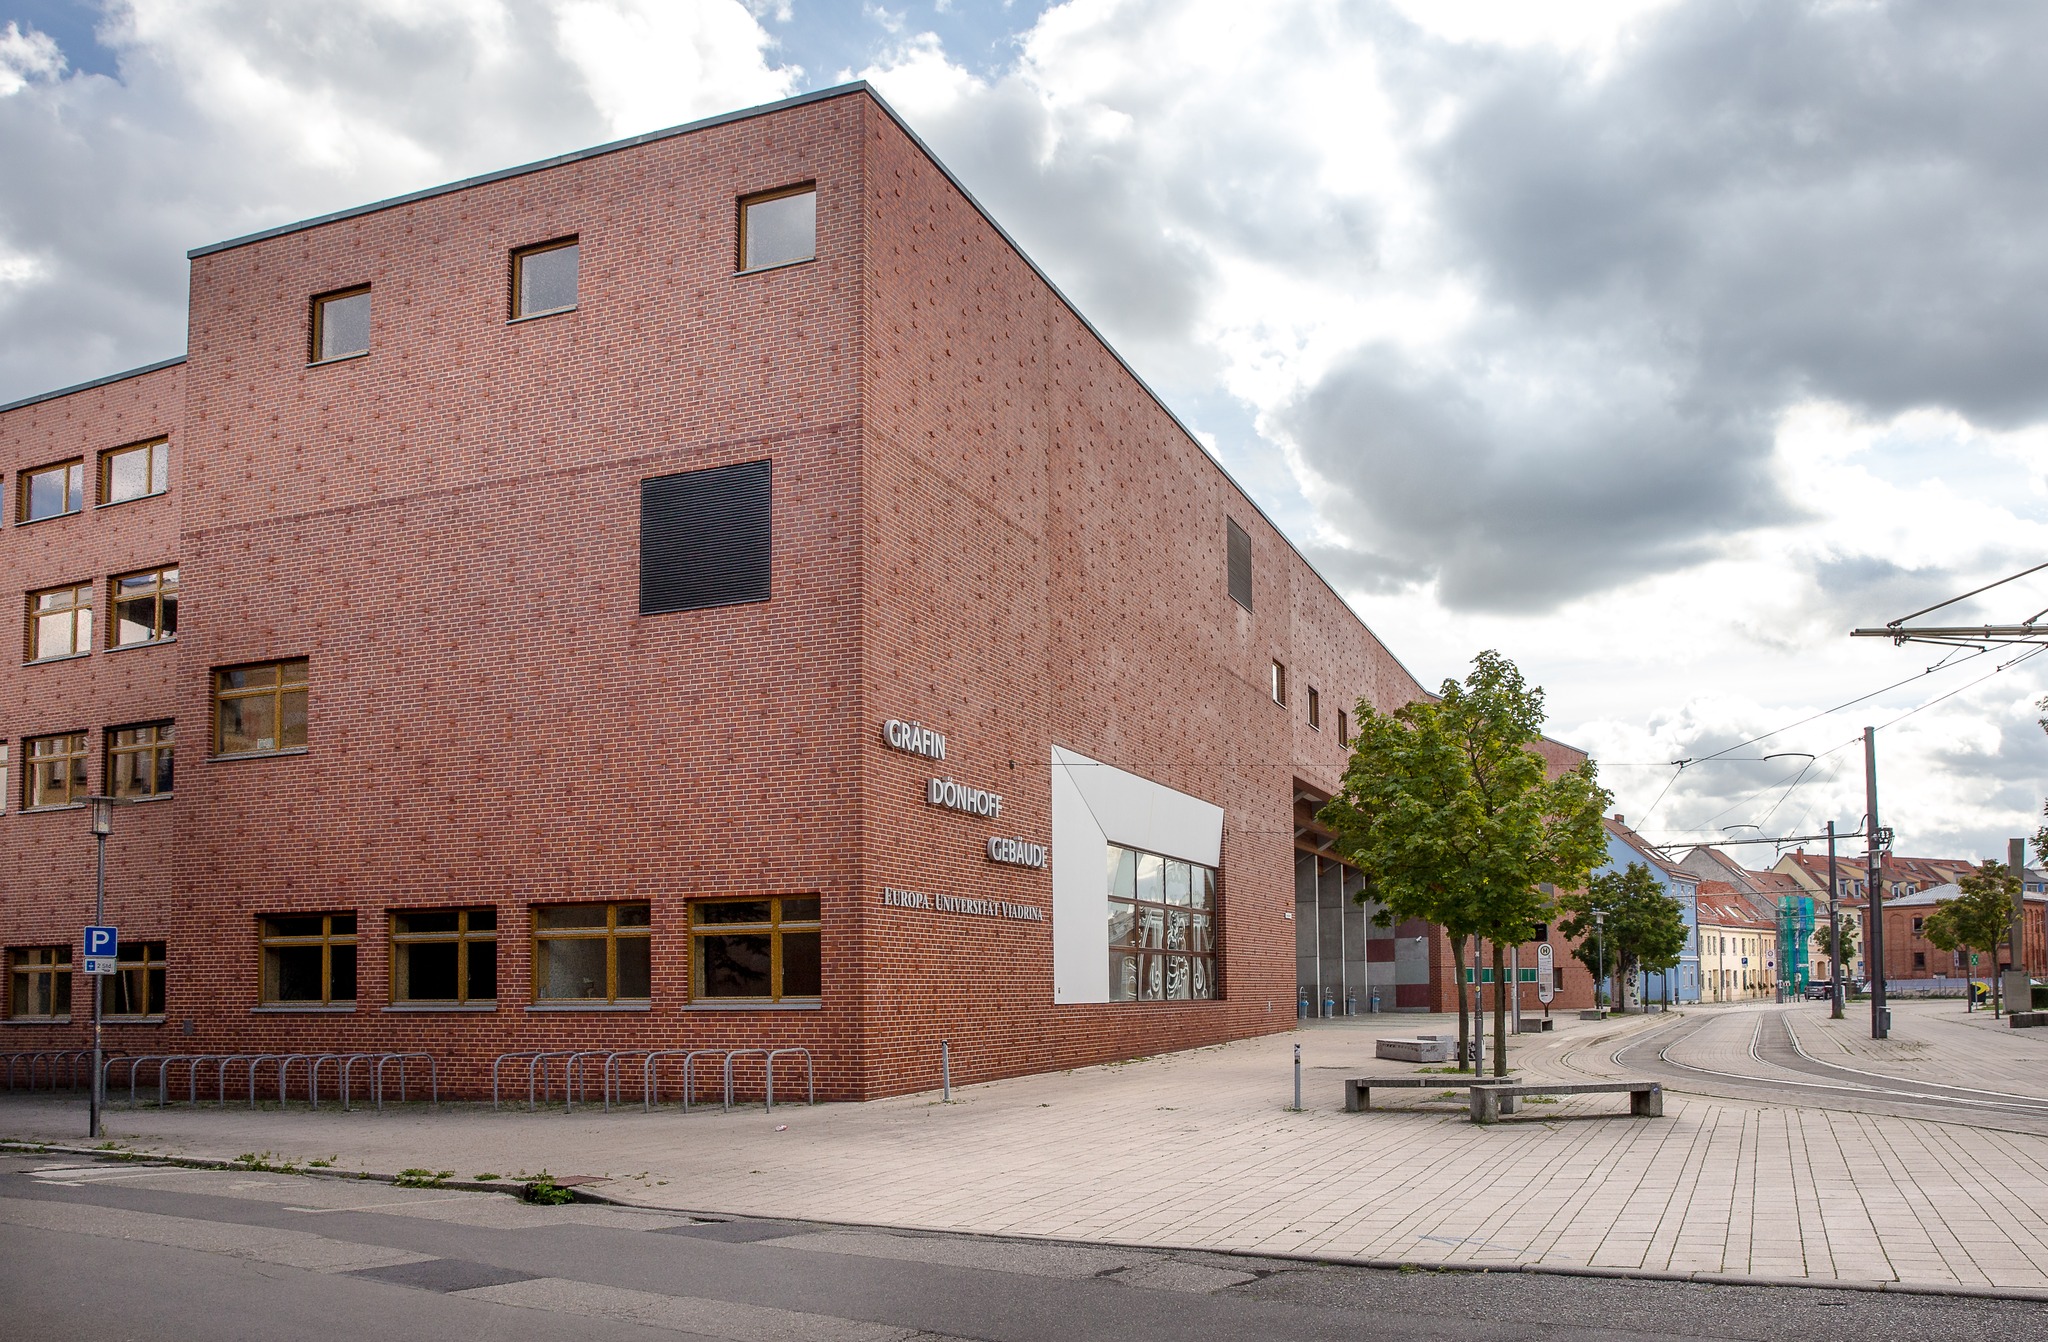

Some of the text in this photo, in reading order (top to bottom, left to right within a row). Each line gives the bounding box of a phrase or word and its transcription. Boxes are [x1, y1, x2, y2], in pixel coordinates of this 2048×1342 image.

[887, 718, 946, 760] GRÄFIN
[931, 776, 1003, 818] DÖNHOFF
[990, 836, 1048, 868] GEBÄUDE
[1001, 901, 1043, 921] VIADRINA
[92, 930, 110, 953] P
